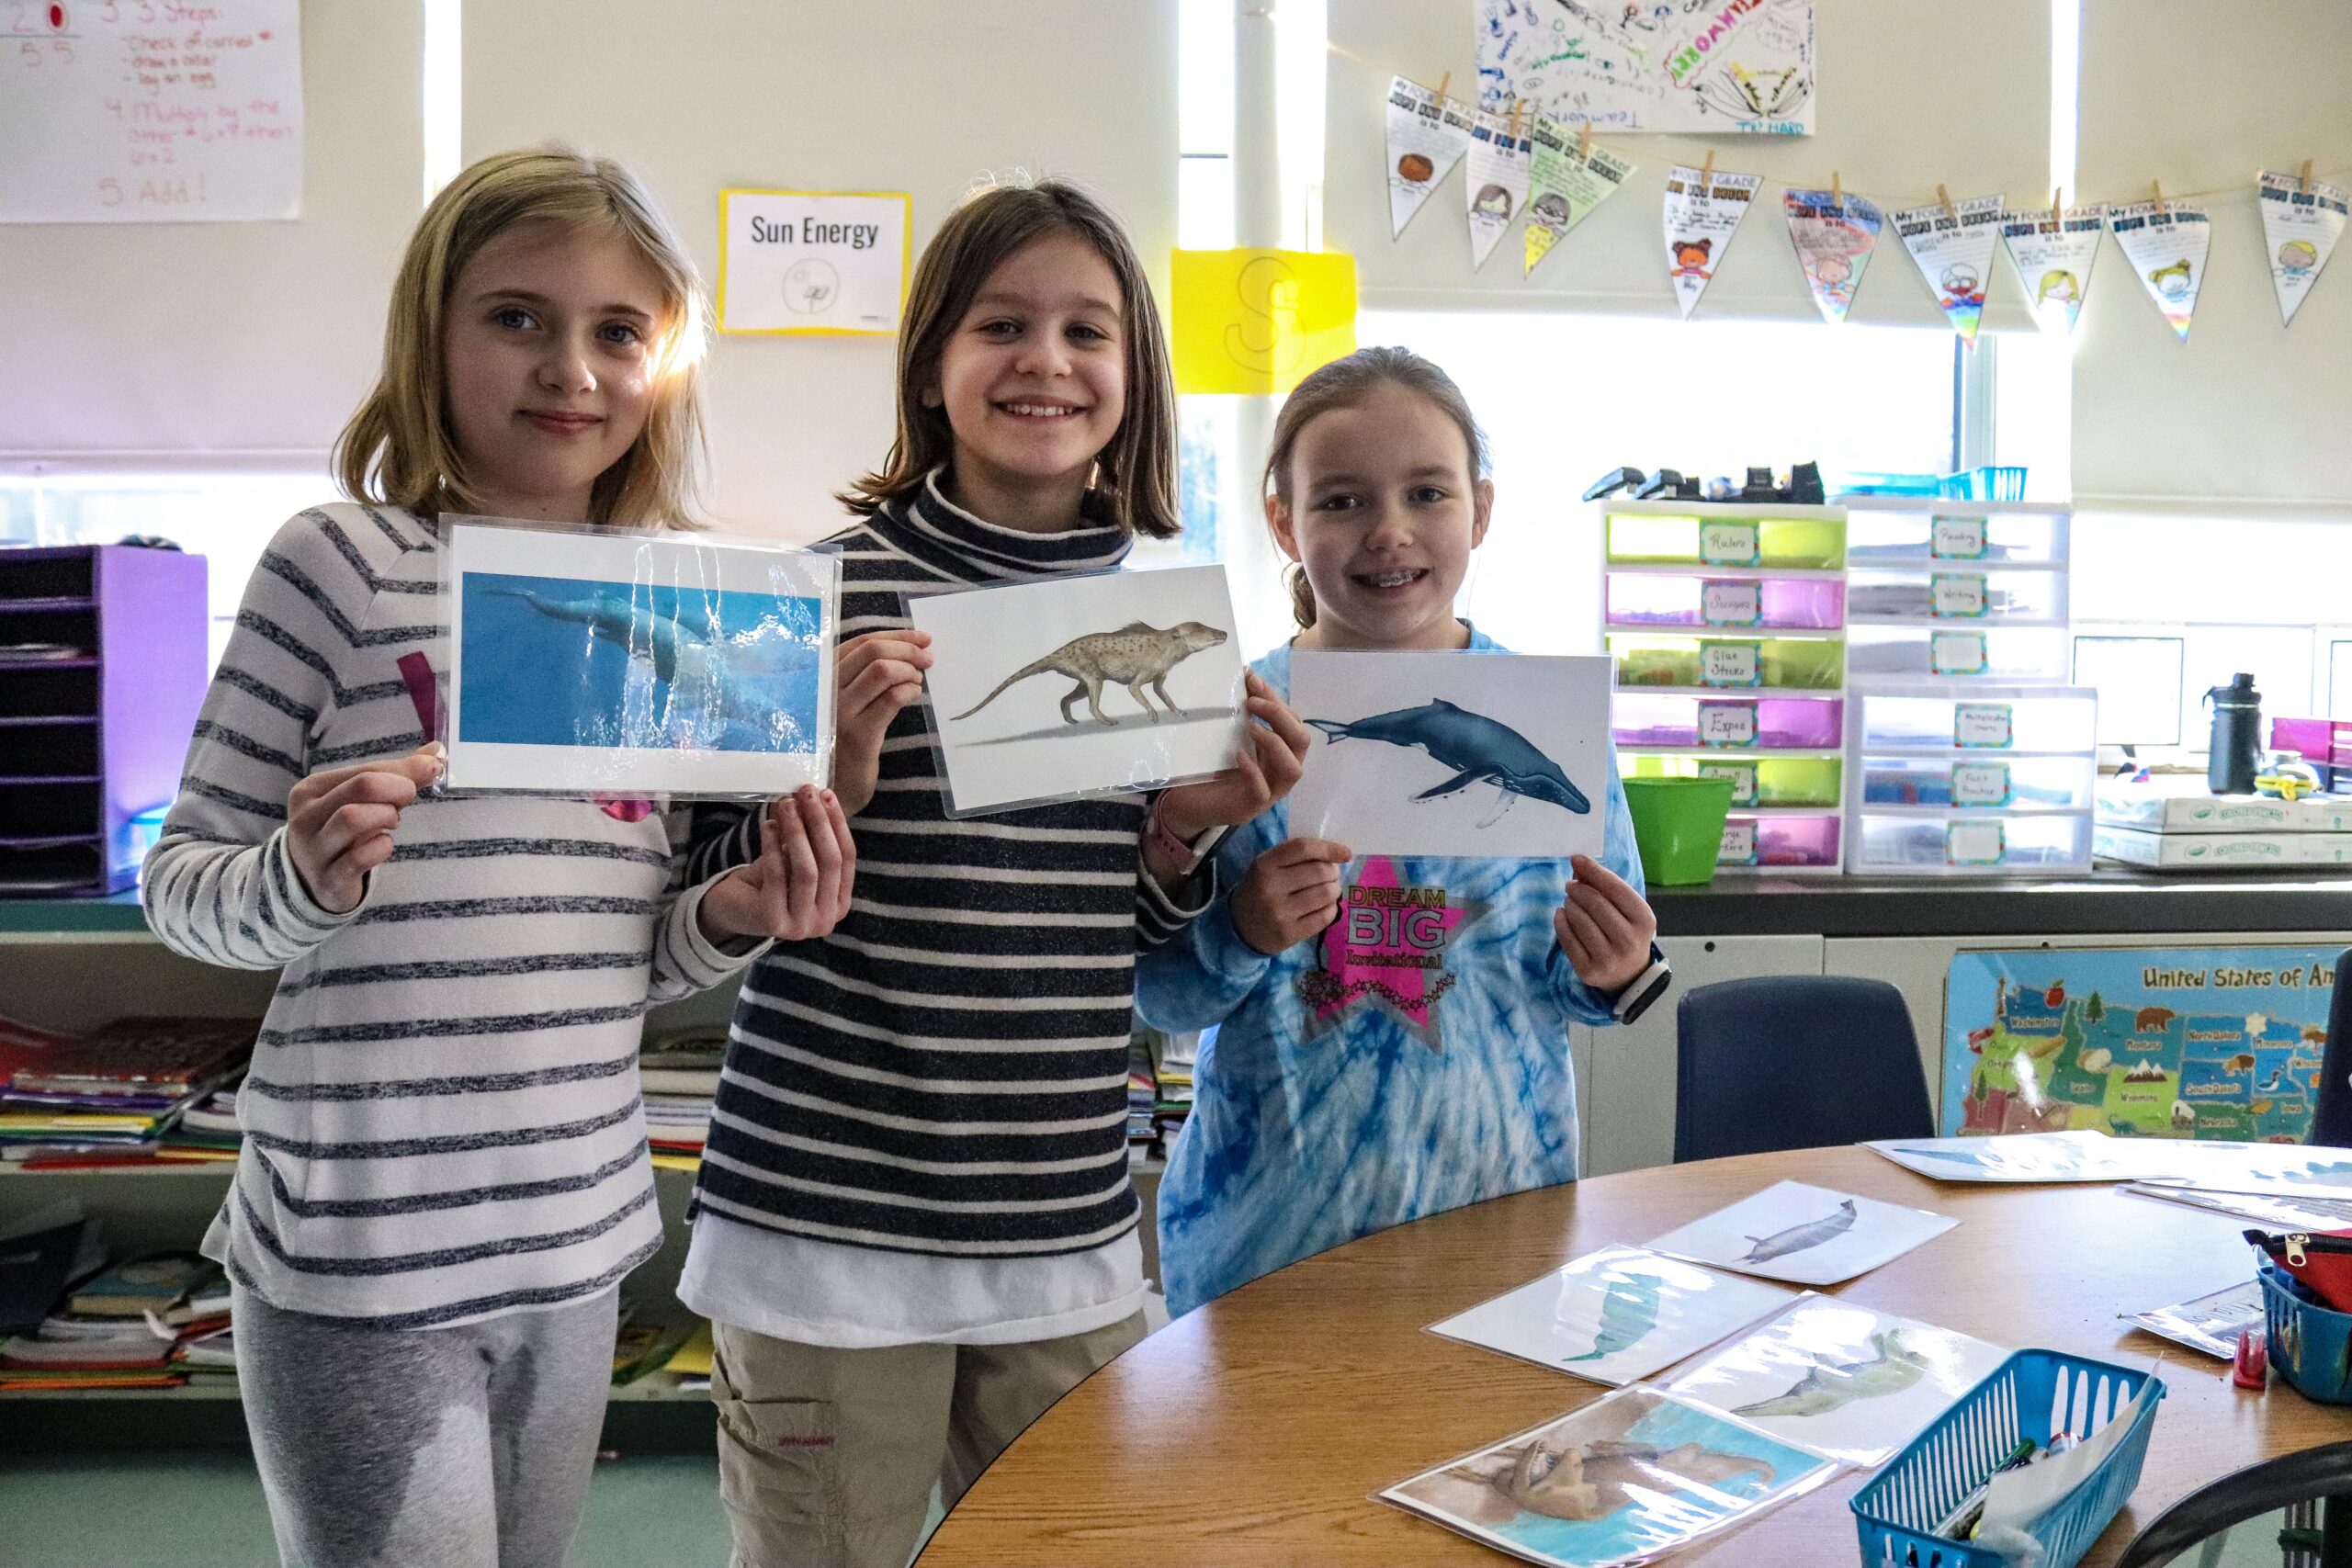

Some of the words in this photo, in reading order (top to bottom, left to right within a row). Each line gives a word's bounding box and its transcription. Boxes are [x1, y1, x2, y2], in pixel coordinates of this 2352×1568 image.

[1767, 121, 1805, 135] HARD
[1895, 211, 1913, 223] My
[2001, 212, 2018, 224] My
[2109, 209, 2126, 221] My
[752, 215, 793, 243] Sun
[803, 217, 878, 250] Energy
[1224, 255, 1306, 374] S
[1943, 588, 1976, 605] Writing
[1713, 649, 1738, 661] Glue
[1348, 885, 1446, 909] DREAM
[1345, 906, 1446, 950] BIG
[1345, 949, 1442, 970] Invitational
[2143, 968, 2205, 988] United
[2214, 968, 2272, 988] States
[2278, 968, 2301, 988] of
[2010, 1018, 2060, 1029] Washington
[2188, 1031, 2212, 1041] North
[2213, 1031, 2241, 1041] Dakota
[2126, 1040, 2162, 1051] Montana
[2187, 1084, 2212, 1095] South
[2213, 1084, 2242, 1095] Dakota
[2120, 1093, 2158, 1102] Wyoming
